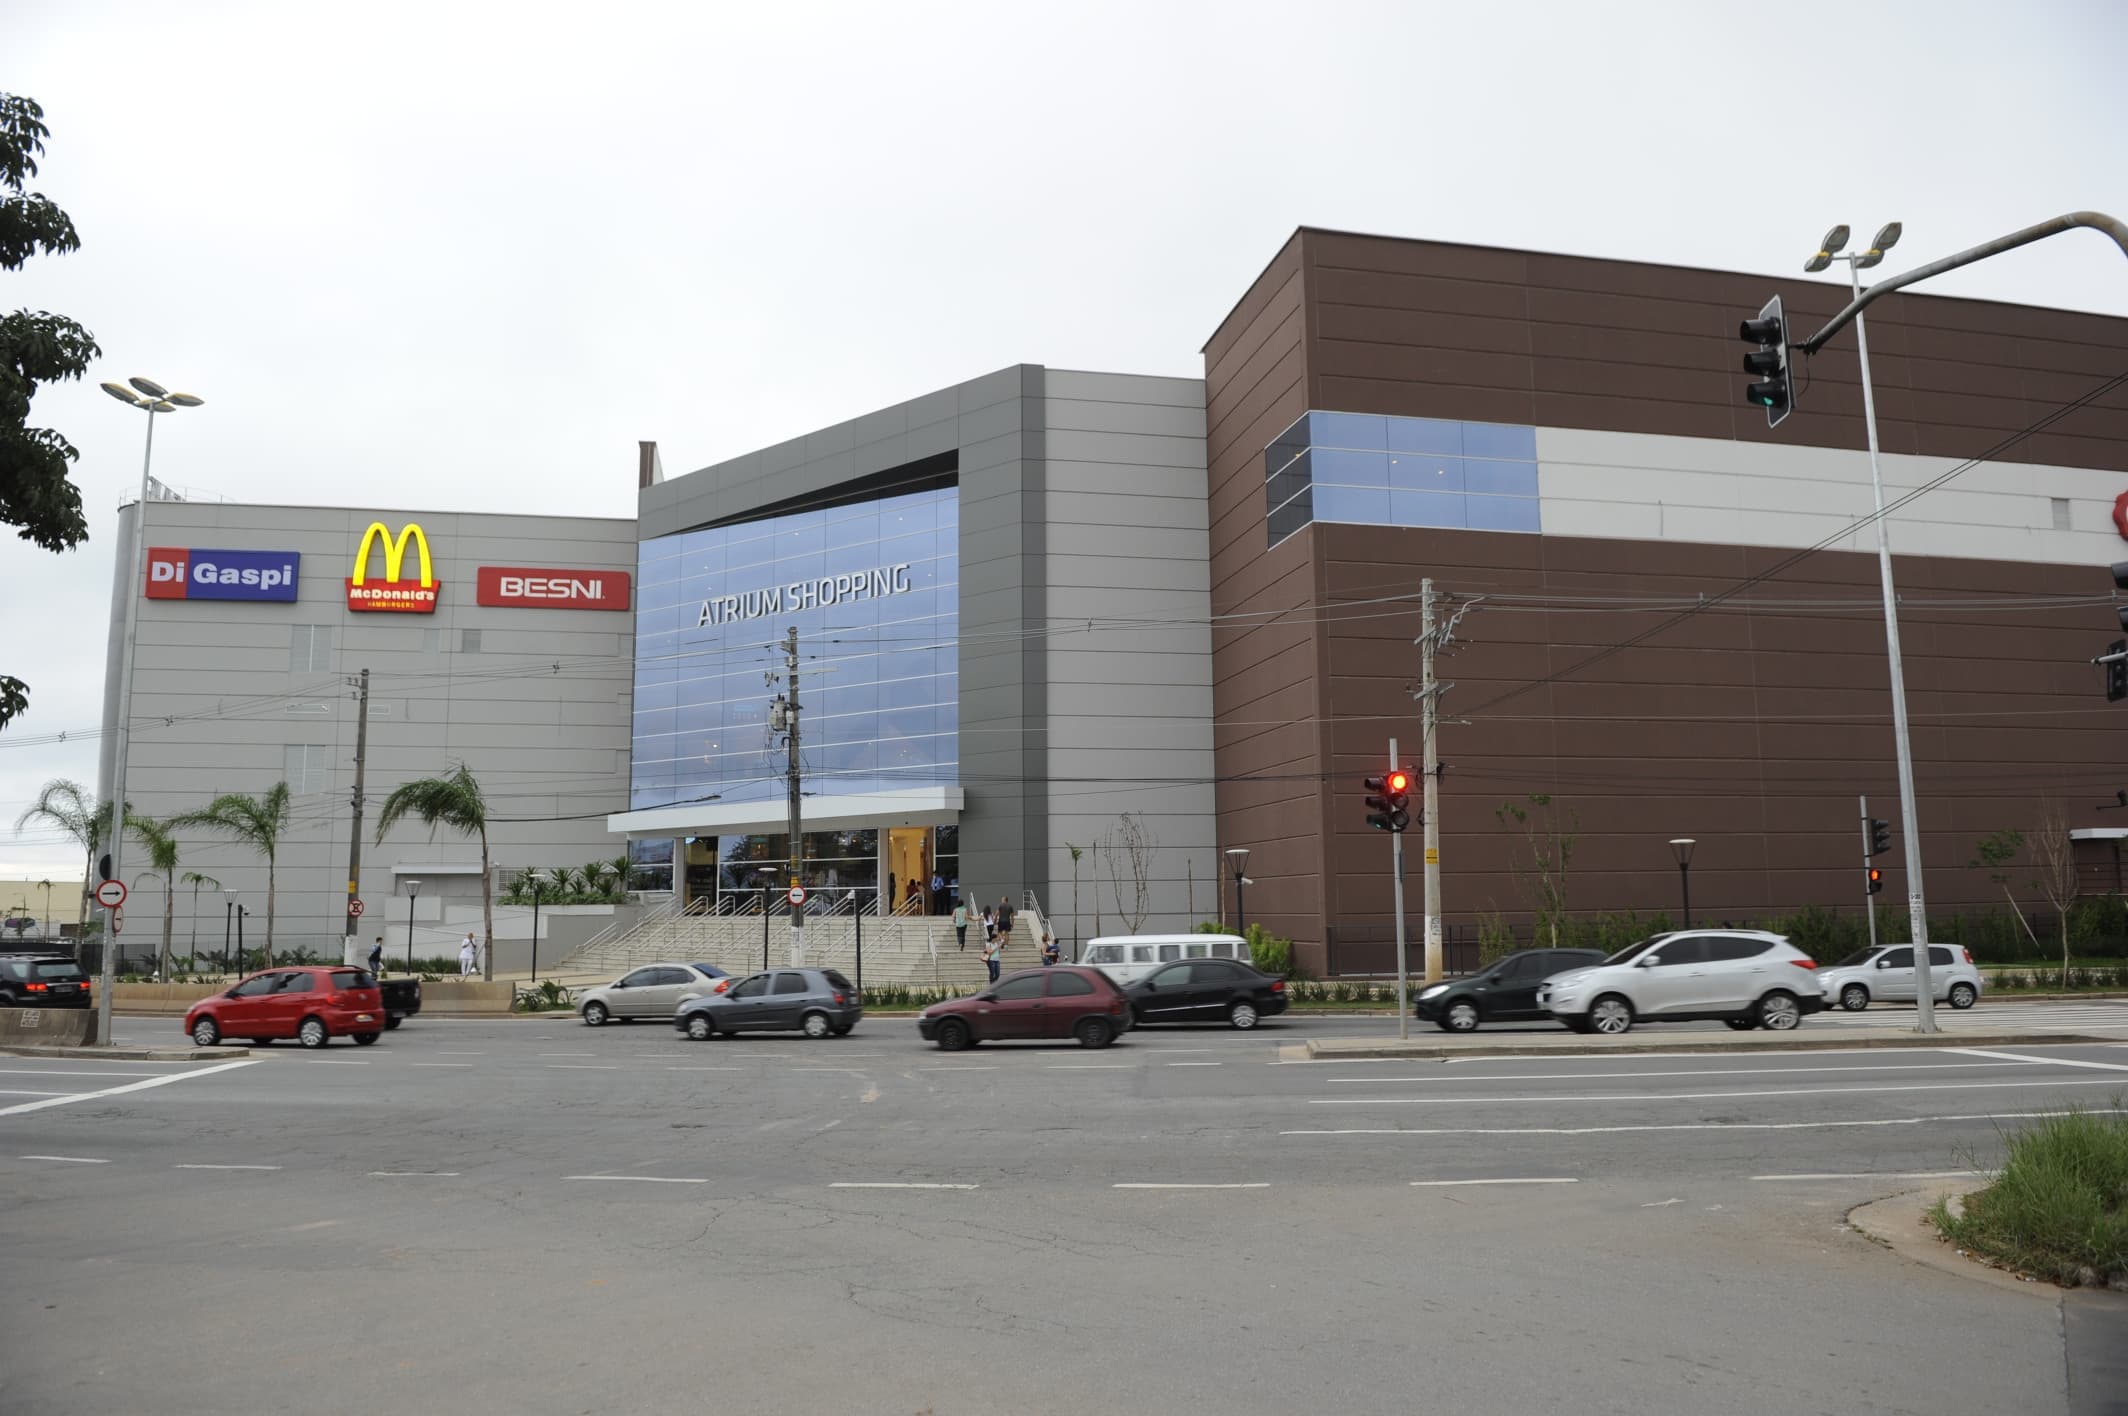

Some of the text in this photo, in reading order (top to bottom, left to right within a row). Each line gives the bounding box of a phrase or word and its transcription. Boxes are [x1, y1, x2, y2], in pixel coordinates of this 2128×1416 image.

[151, 561, 292, 590] Di Gaspi
[500, 576, 602, 599] BESNI
[350, 588, 435, 601] McDonald's
[697, 563, 910, 627] ATRIUM SHOPPING
